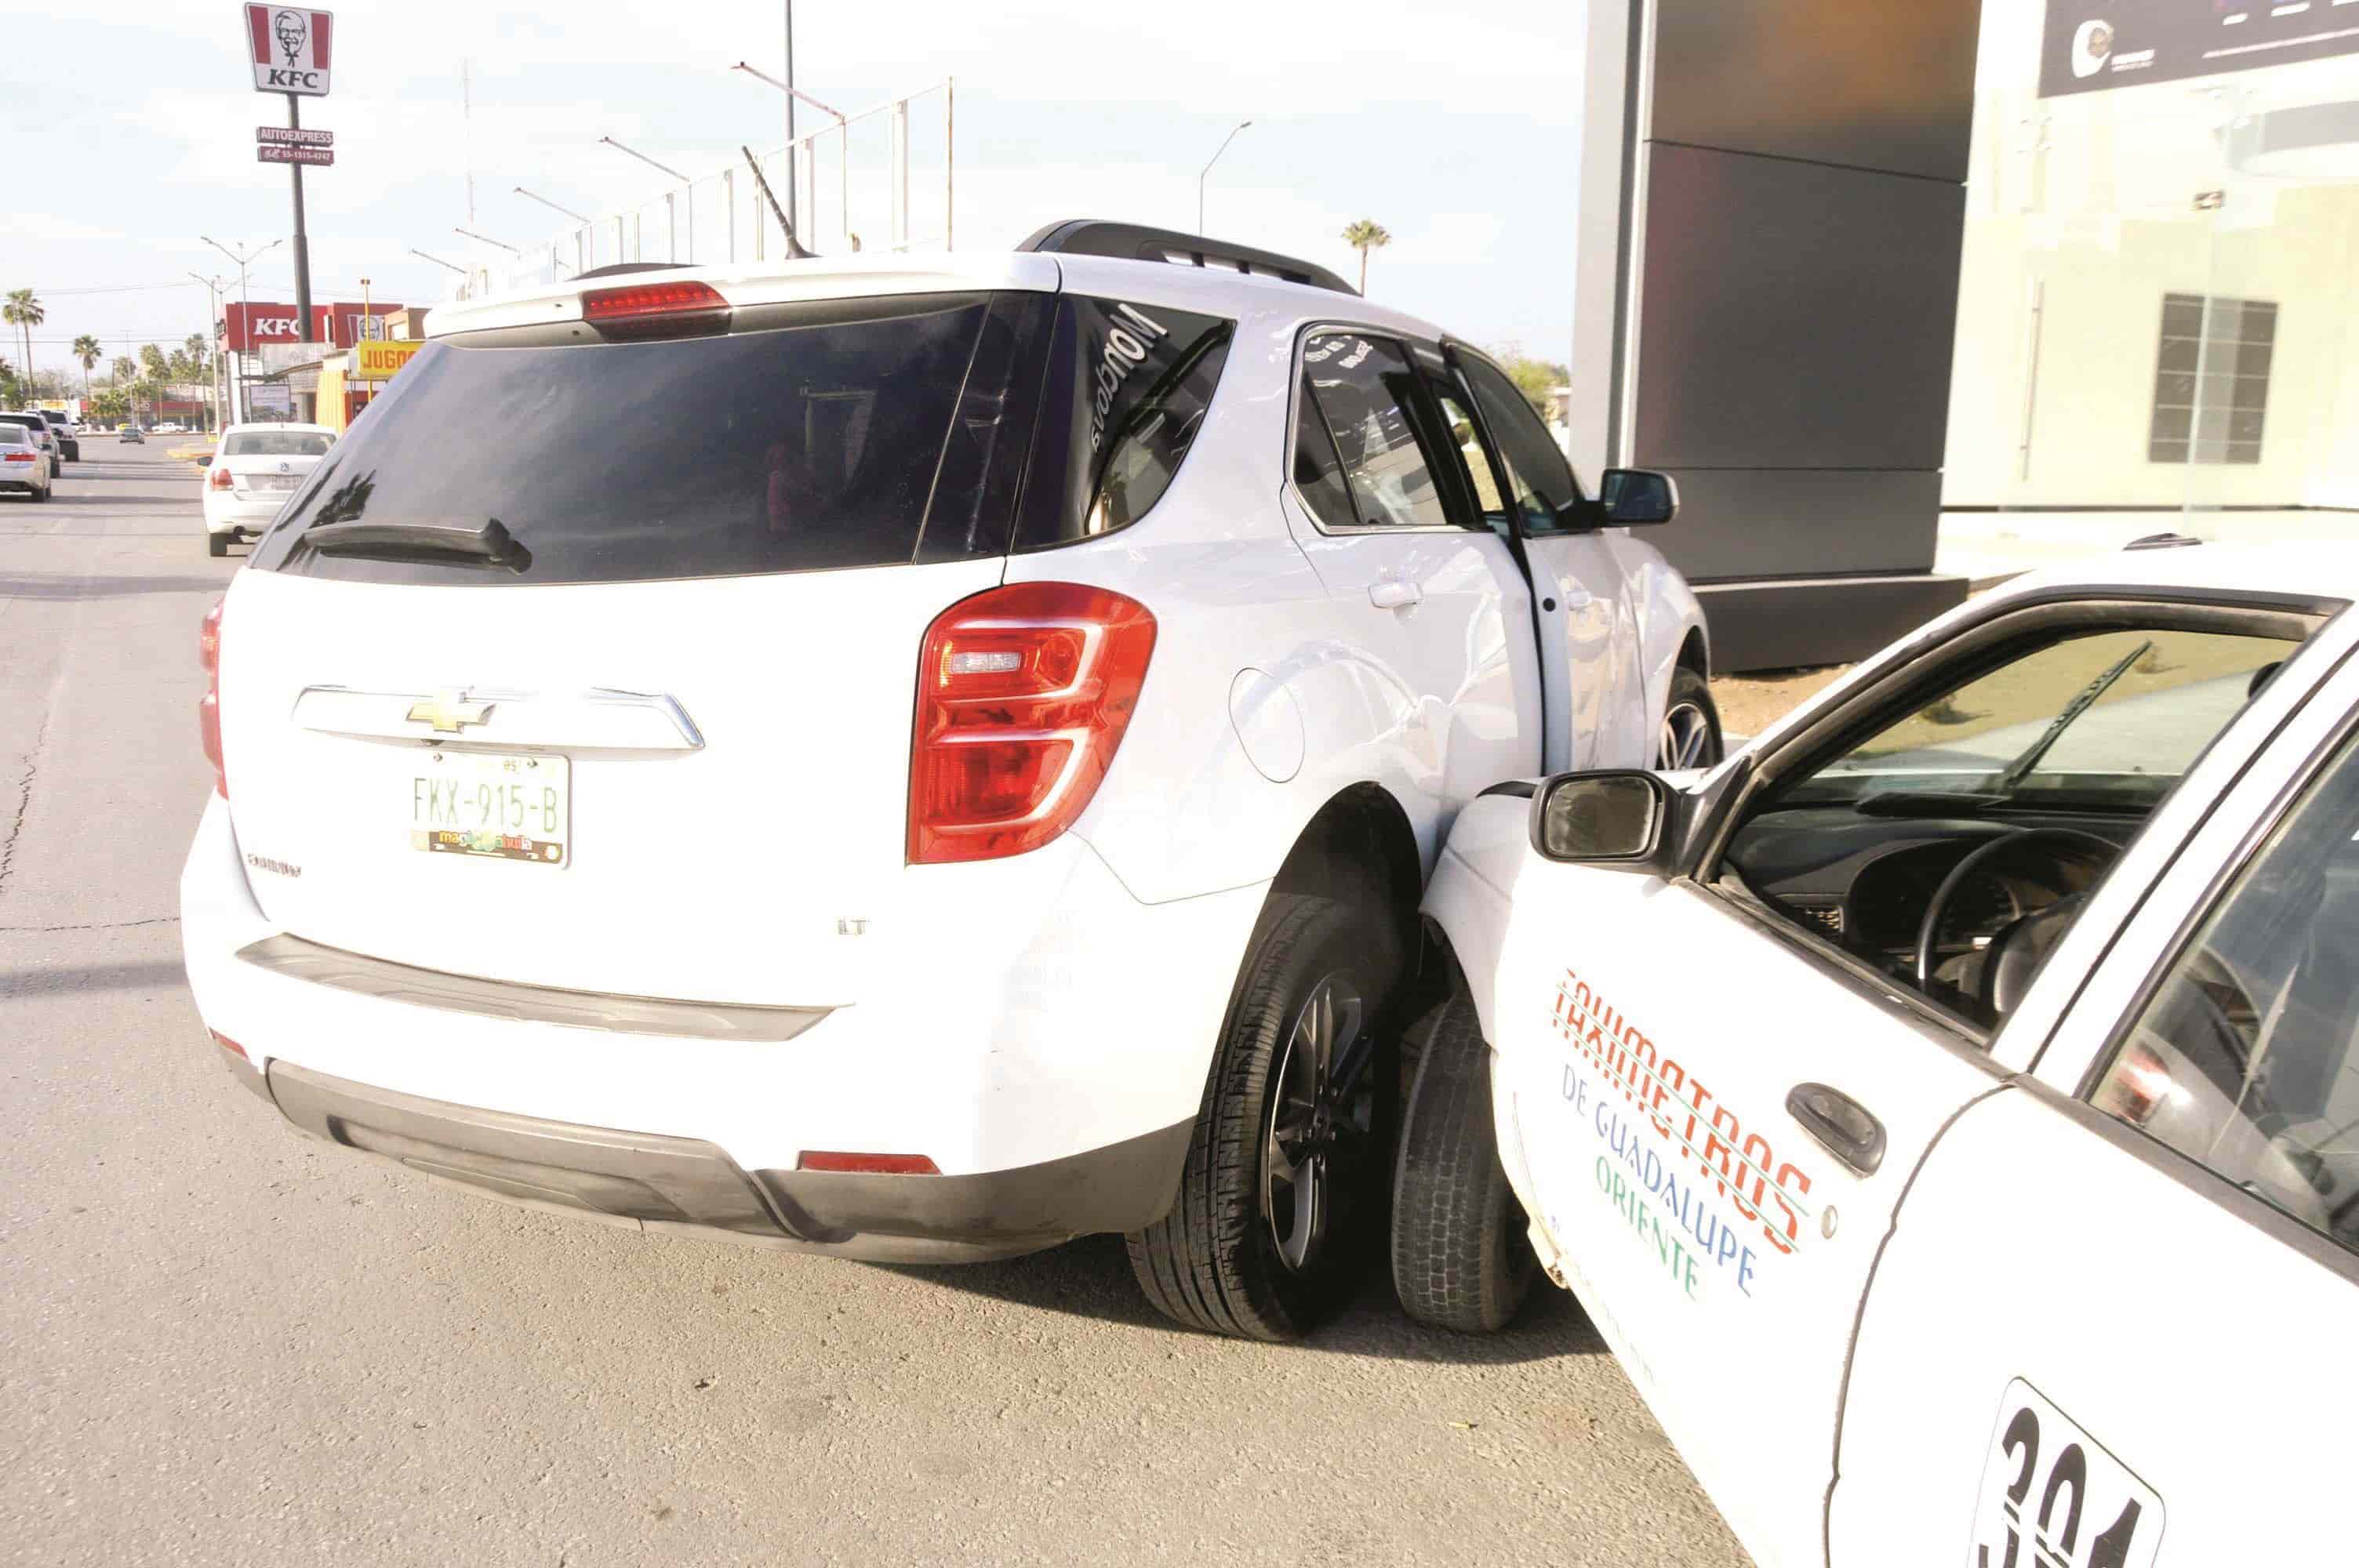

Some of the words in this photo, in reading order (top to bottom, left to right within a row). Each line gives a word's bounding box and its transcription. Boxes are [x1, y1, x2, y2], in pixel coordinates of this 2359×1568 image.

[267, 69, 318, 89] KFC
[261, 129, 333, 143] AUTOEXPRESS
[415, 777, 557, 833] FKX-915-B
[837, 916, 867, 935] LT
[1562, 1063, 1588, 1117] DE
[1596, 1101, 1757, 1298] GUADALUPE
[1596, 1155, 1700, 1302] ORIENTE
